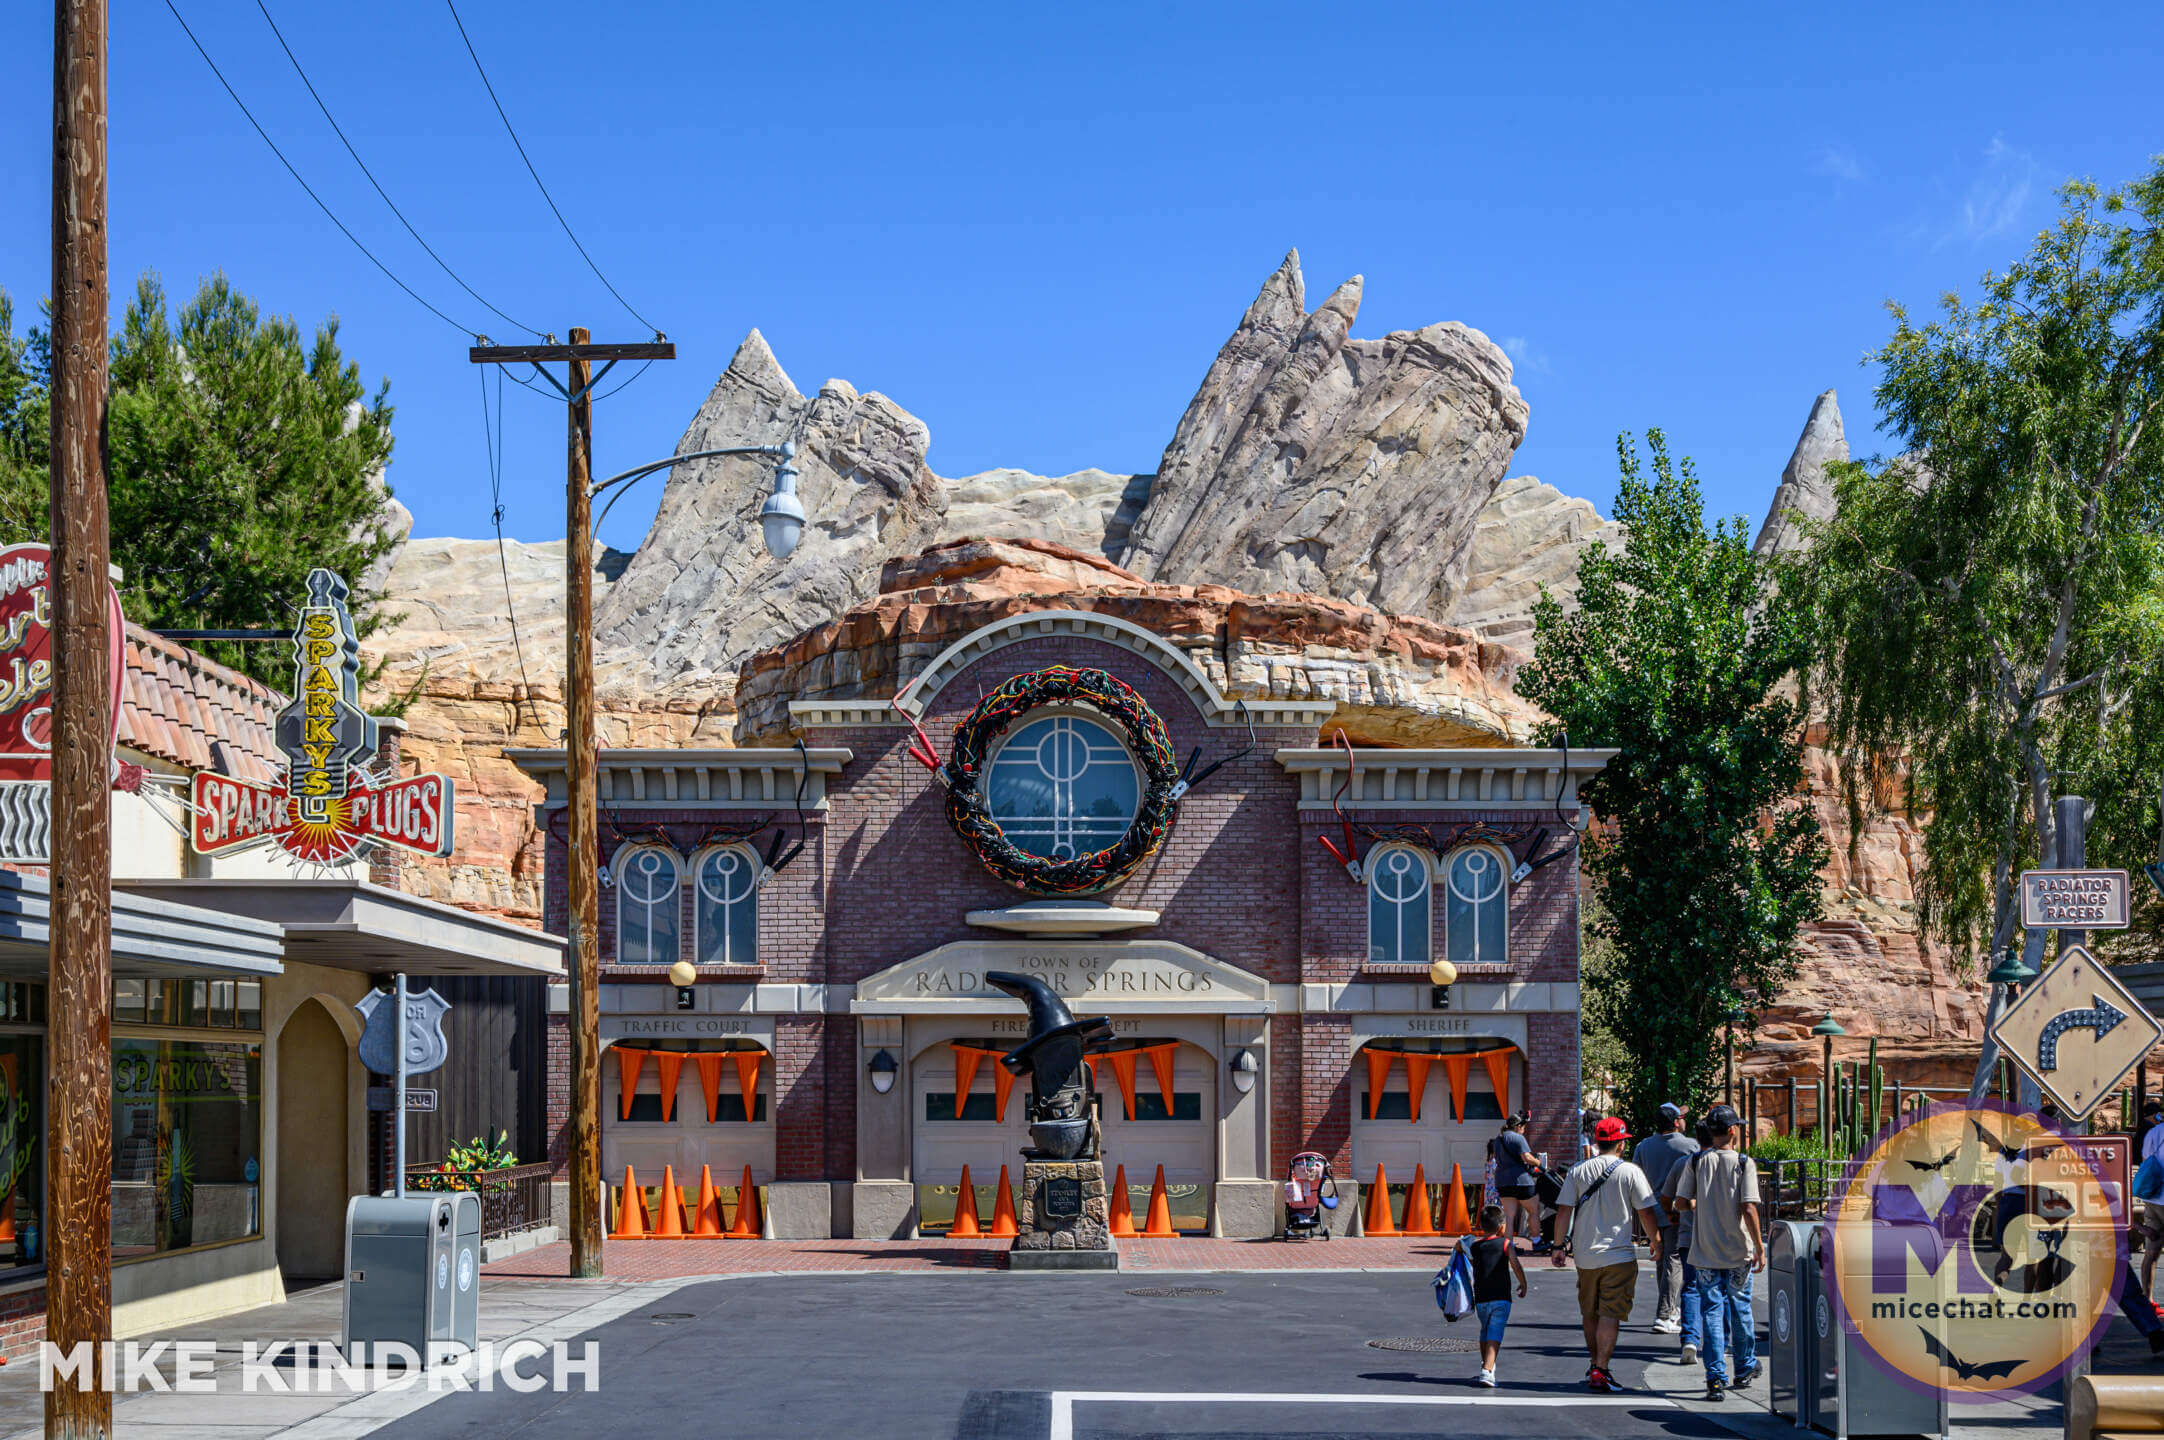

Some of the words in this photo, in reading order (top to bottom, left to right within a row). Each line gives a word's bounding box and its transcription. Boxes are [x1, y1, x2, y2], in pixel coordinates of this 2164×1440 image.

[303, 614, 338, 796] SPARKYS
[202, 781, 292, 843] SPARK
[351, 781, 438, 845] PLUGS
[2038, 878, 2113, 892] RADIATOR
[2043, 892, 2109, 906] SPRINGS
[2047, 906, 2106, 919] RACERS
[1018, 956, 1070, 969] TOWN
[1079, 956, 1101, 969] OF
[916, 971, 1069, 992] RADIR
[1086, 970, 1213, 993] SPRINGS
[622, 1020, 687, 1033] TRAFFIC
[696, 1020, 751, 1033] COURT
[992, 1020, 1026, 1032] FIRE
[1408, 1019, 1470, 1032] SHERIFF
[2043, 1146, 2116, 1160] STANLEY'S
[2060, 1163, 2100, 1175] OASIS
